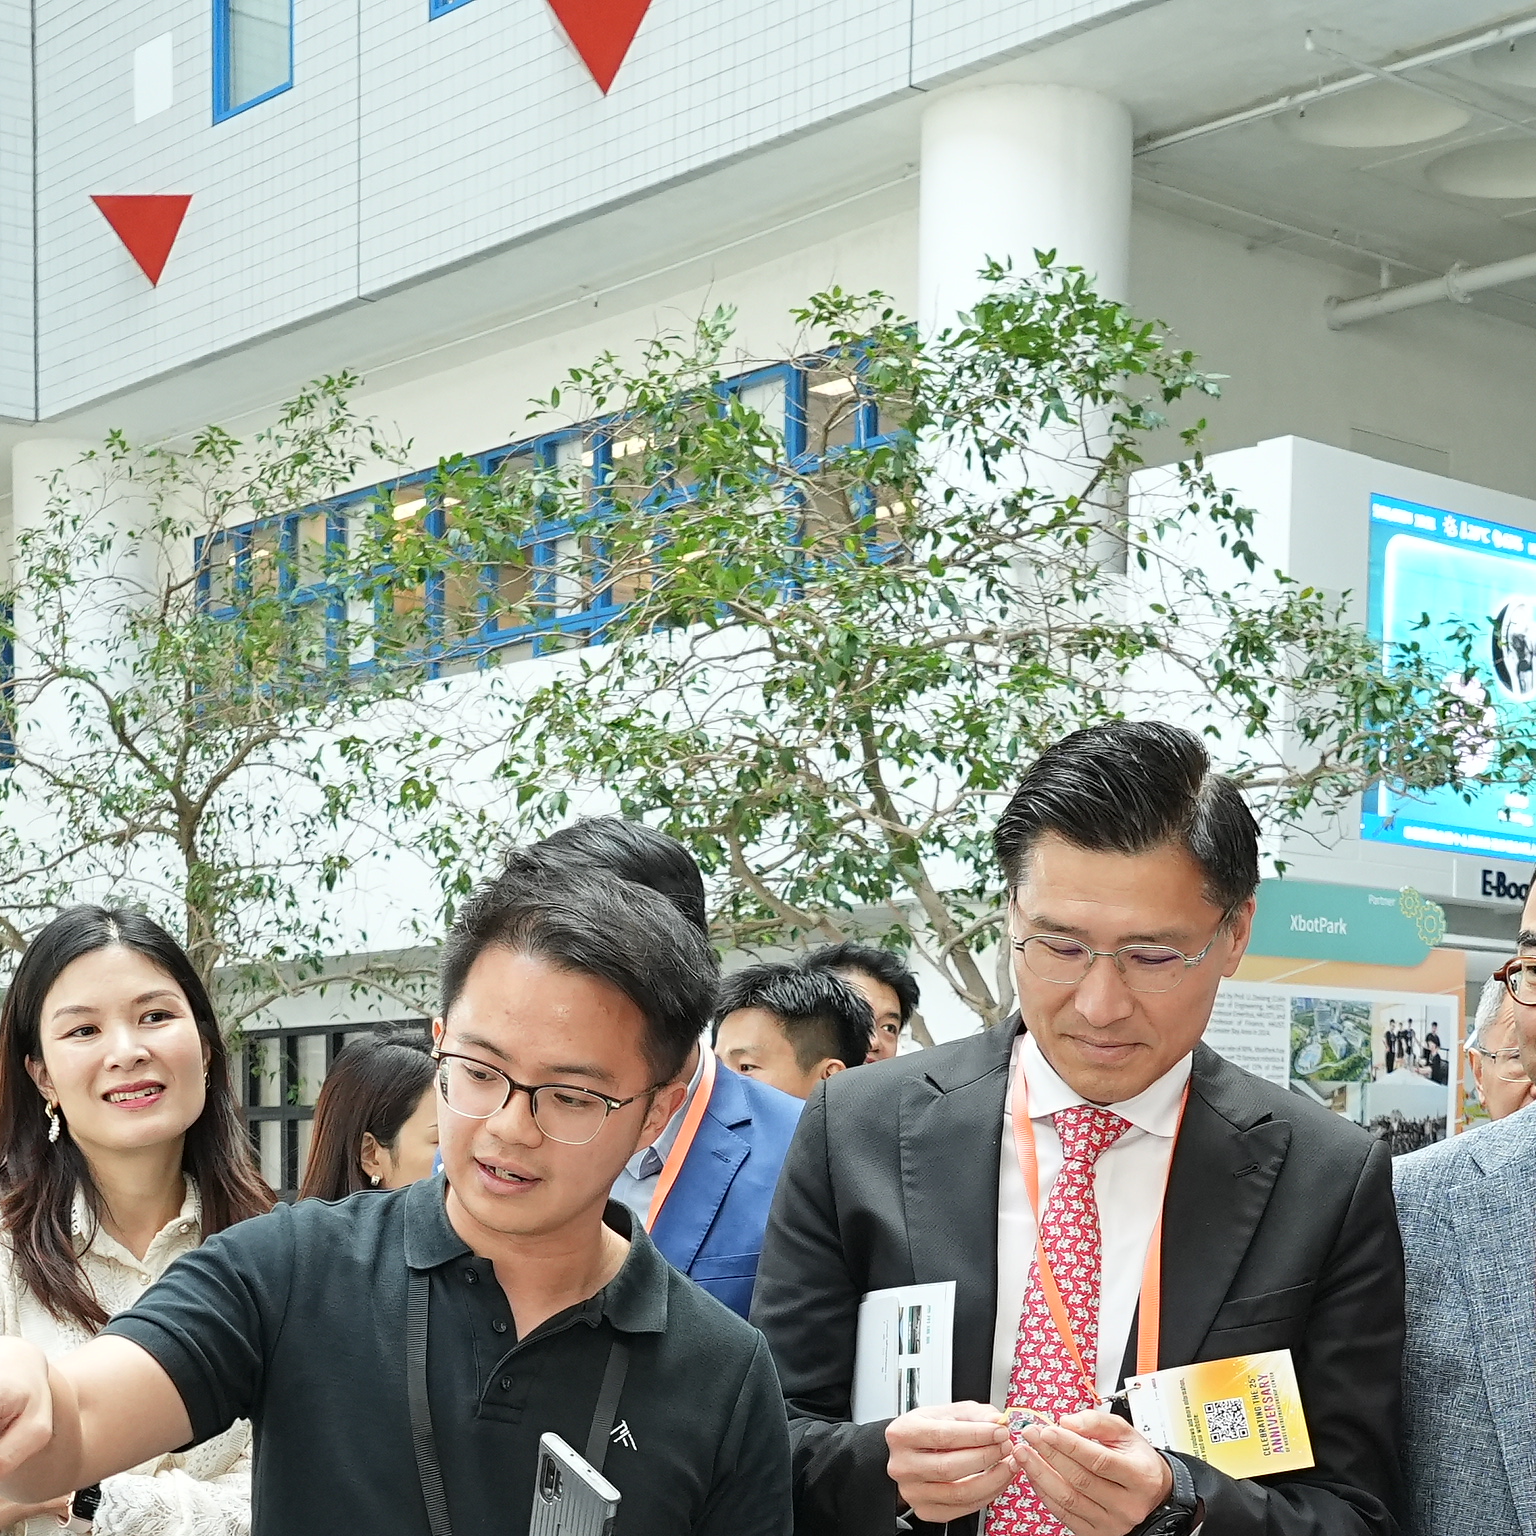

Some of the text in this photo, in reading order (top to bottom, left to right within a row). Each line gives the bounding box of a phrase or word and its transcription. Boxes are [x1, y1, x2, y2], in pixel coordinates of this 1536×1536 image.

[1368, 894, 1396, 907] Partner
[1290, 914, 1347, 935] XbotPark
[1251, 1389, 1260, 1404] THE
[1258, 1374, 1284, 1453] ANNIVERSARY
[1254, 1406, 1271, 1457] CELEBRATING
